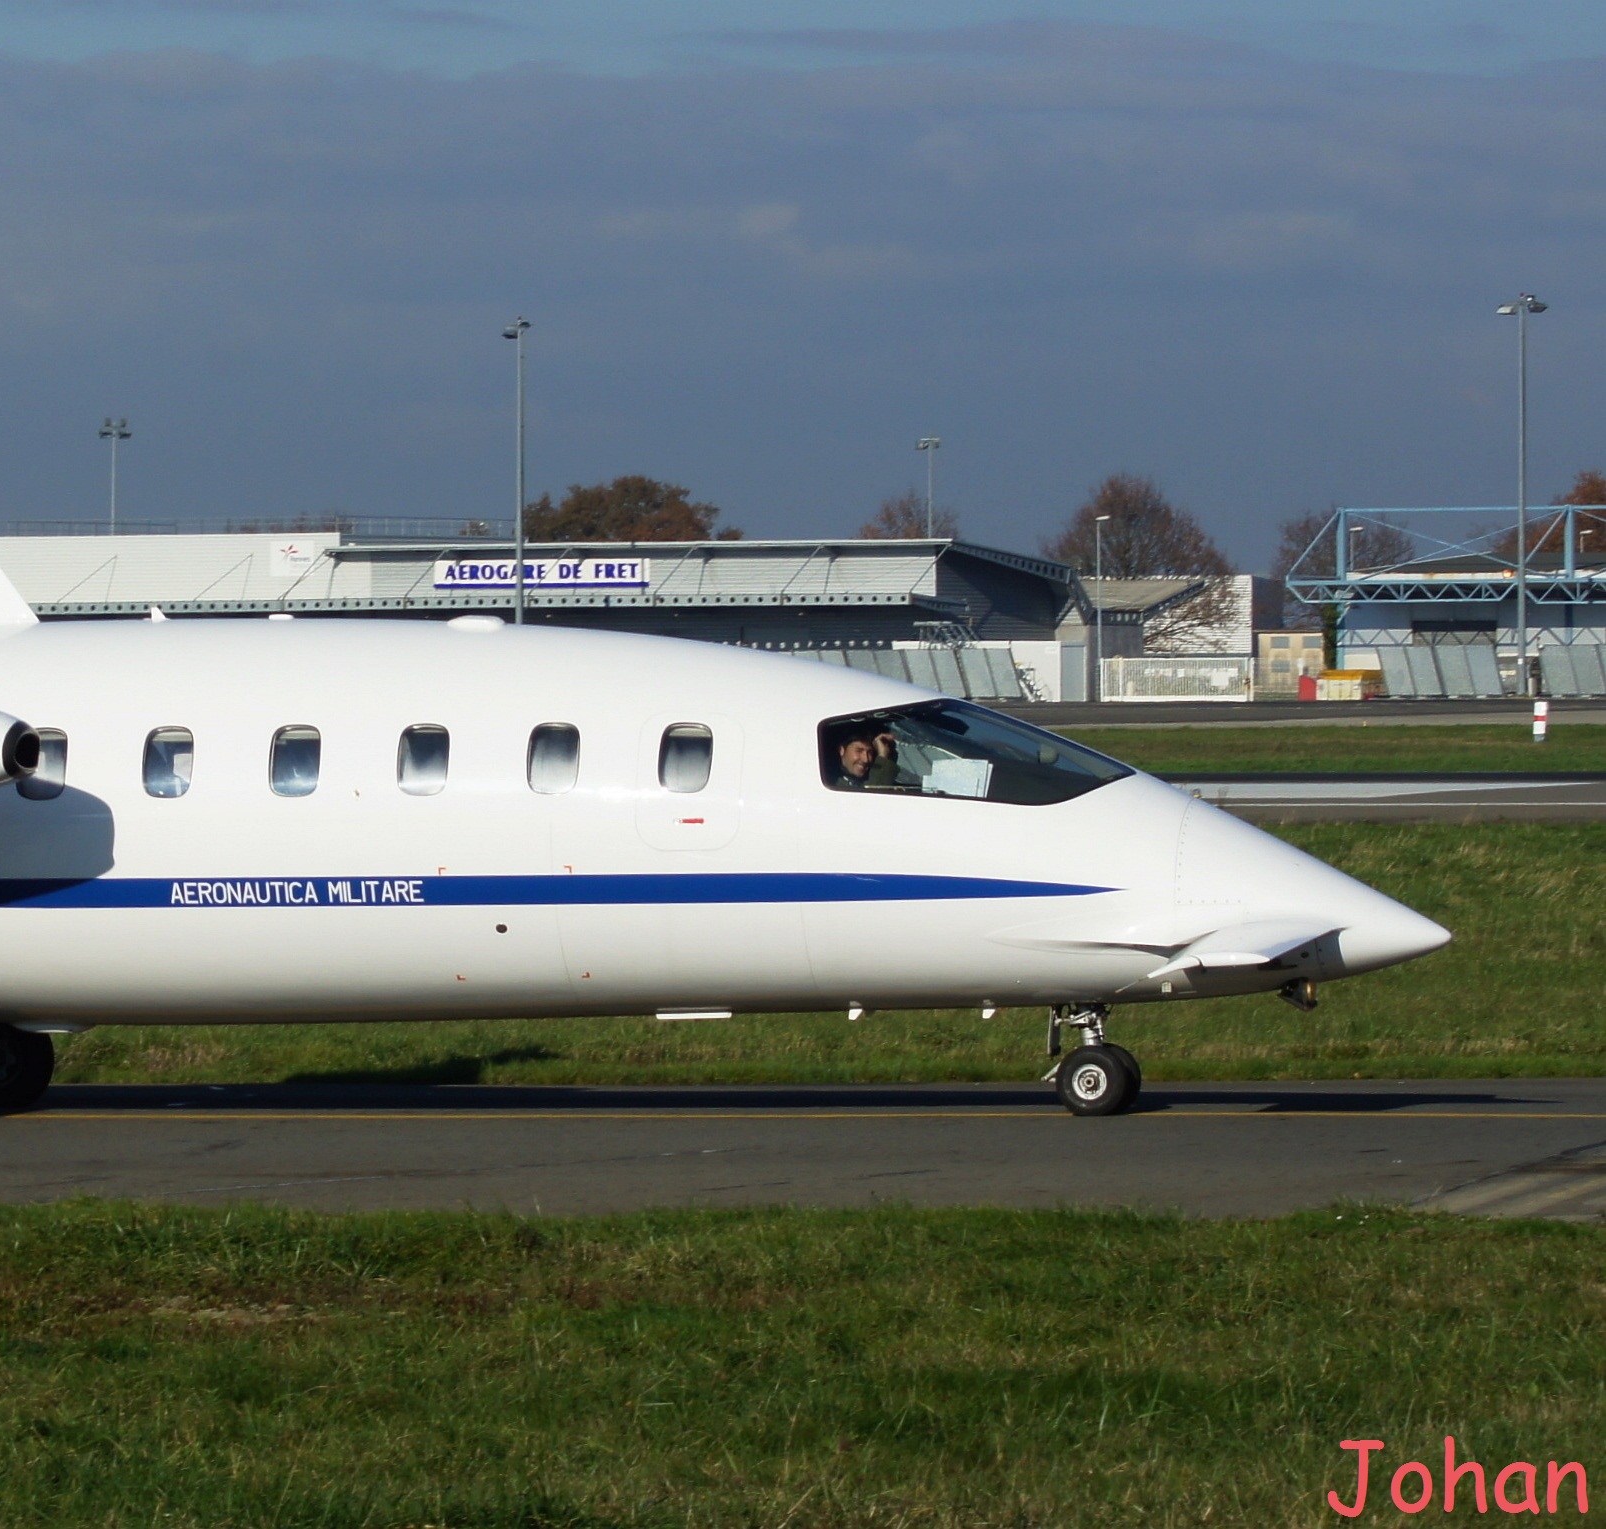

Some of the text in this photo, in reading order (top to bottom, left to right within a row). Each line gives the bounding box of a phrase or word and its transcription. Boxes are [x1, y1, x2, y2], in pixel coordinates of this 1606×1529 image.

[445, 563, 639, 580] AEROGARE DE FRET
[171, 880, 425, 904] AERONAUTICA MILITARE
